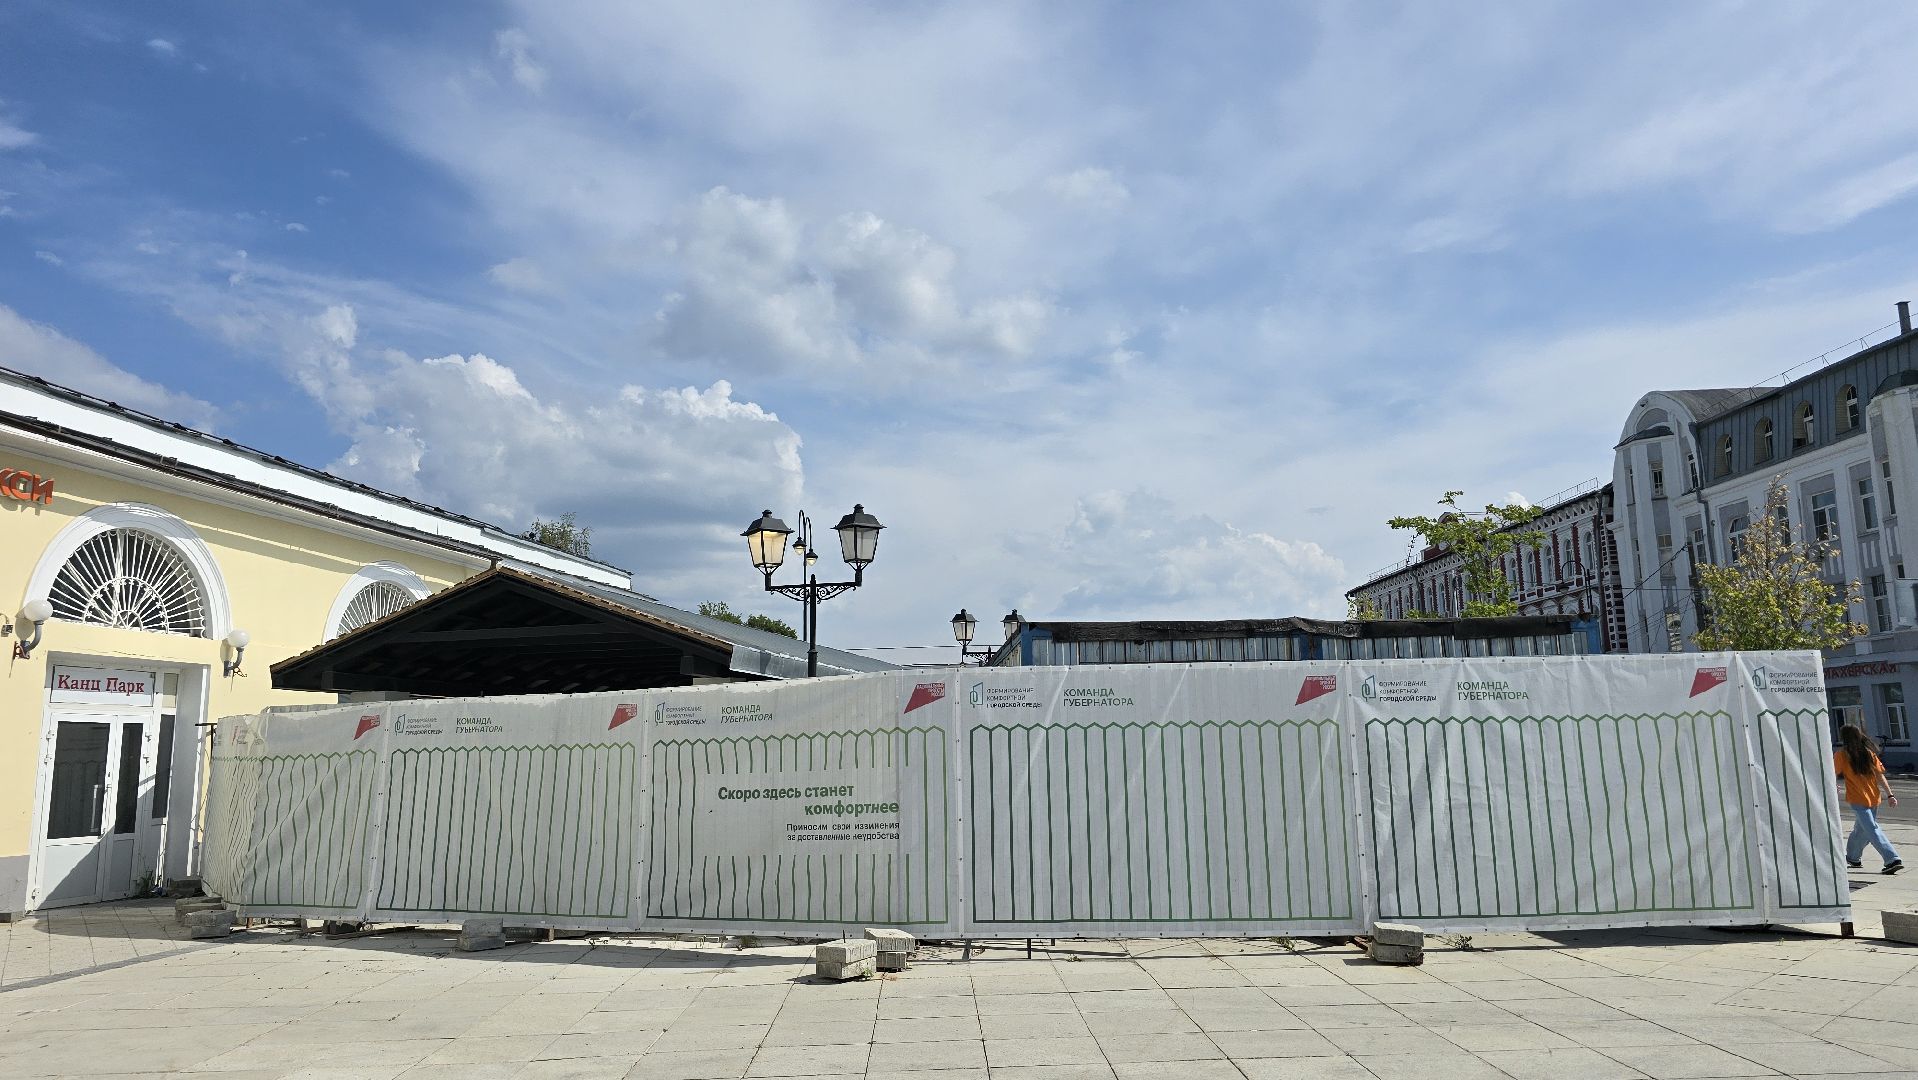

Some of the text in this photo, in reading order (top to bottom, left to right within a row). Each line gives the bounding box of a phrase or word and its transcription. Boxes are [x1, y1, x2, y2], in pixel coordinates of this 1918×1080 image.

[58, 675, 144, 696] Канц Парк
[1457, 681, 1509, 690] КОМАНДА
[1063, 688, 1115, 697] КОМАНДА
[1458, 691, 1529, 701] ГУБЕРНАТОРА
[1063, 698, 1134, 707] ГУБЕРНАТОРА
[1379, 694, 1415, 702] ГОРОДСКОЙ
[721, 705, 761, 714] КОМАНДА
[456, 717, 492, 725] КОМАНДА
[720, 714, 773, 723] ГУБЕРНАТОРА
[718, 785, 854, 802] Скоро здесь станет
[804, 800, 899, 817] комфортнее
[786, 823, 828, 833] Приносим
[854, 822, 900, 830] извинения
[797, 834, 851, 842] доставленные
[853, 832, 900, 841] неудобства
